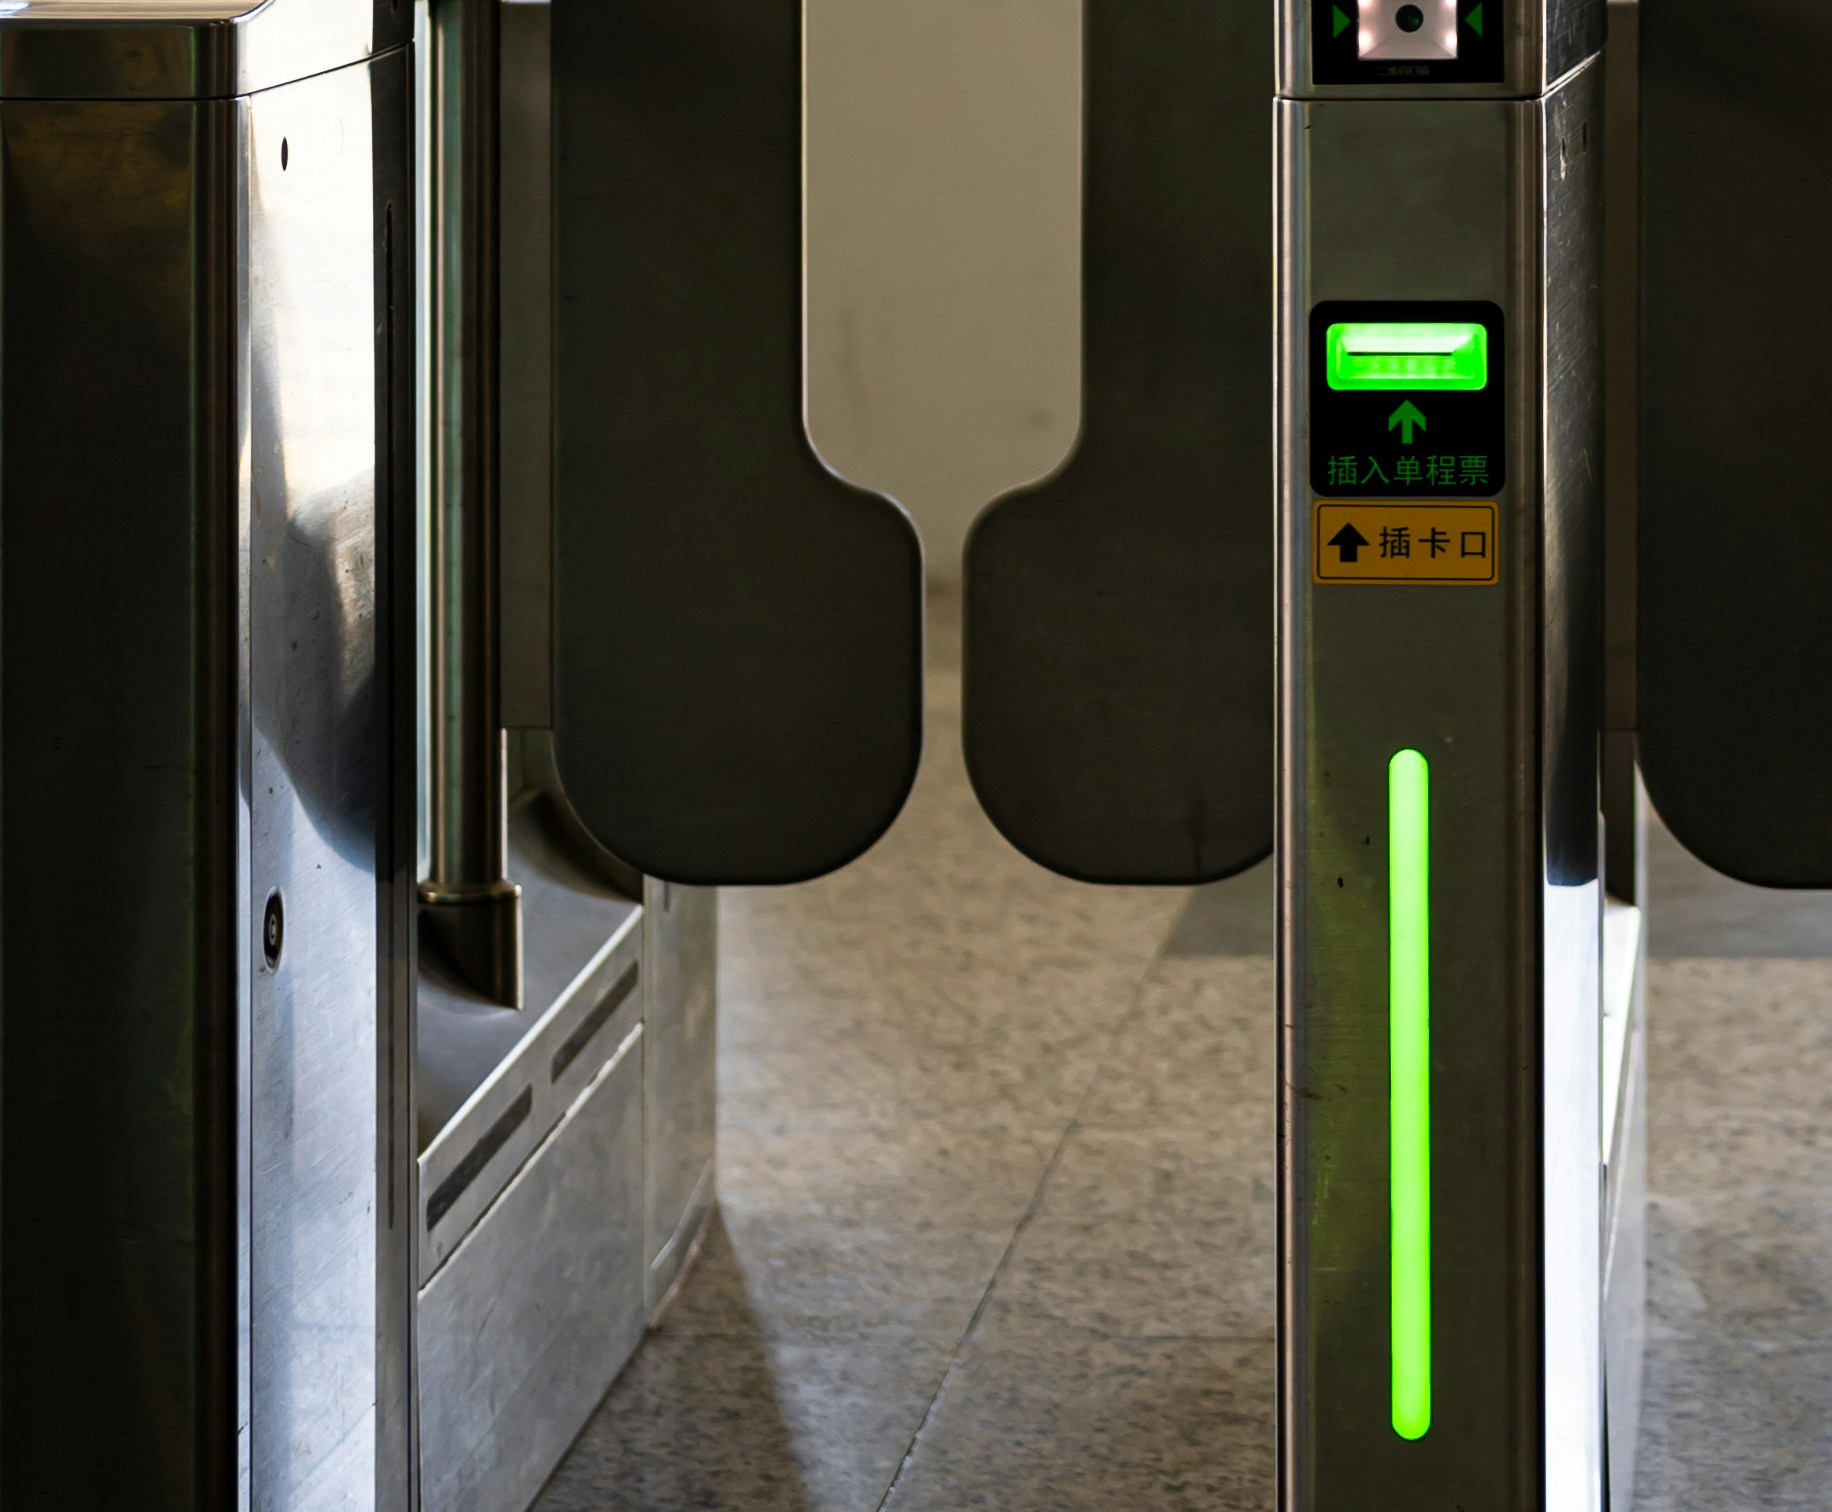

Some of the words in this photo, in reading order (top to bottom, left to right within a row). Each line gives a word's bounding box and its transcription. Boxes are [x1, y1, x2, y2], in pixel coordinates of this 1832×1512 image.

[1327, 455, 1489, 486] 插入单程票
[1379, 526, 1486, 558] 插卡口
